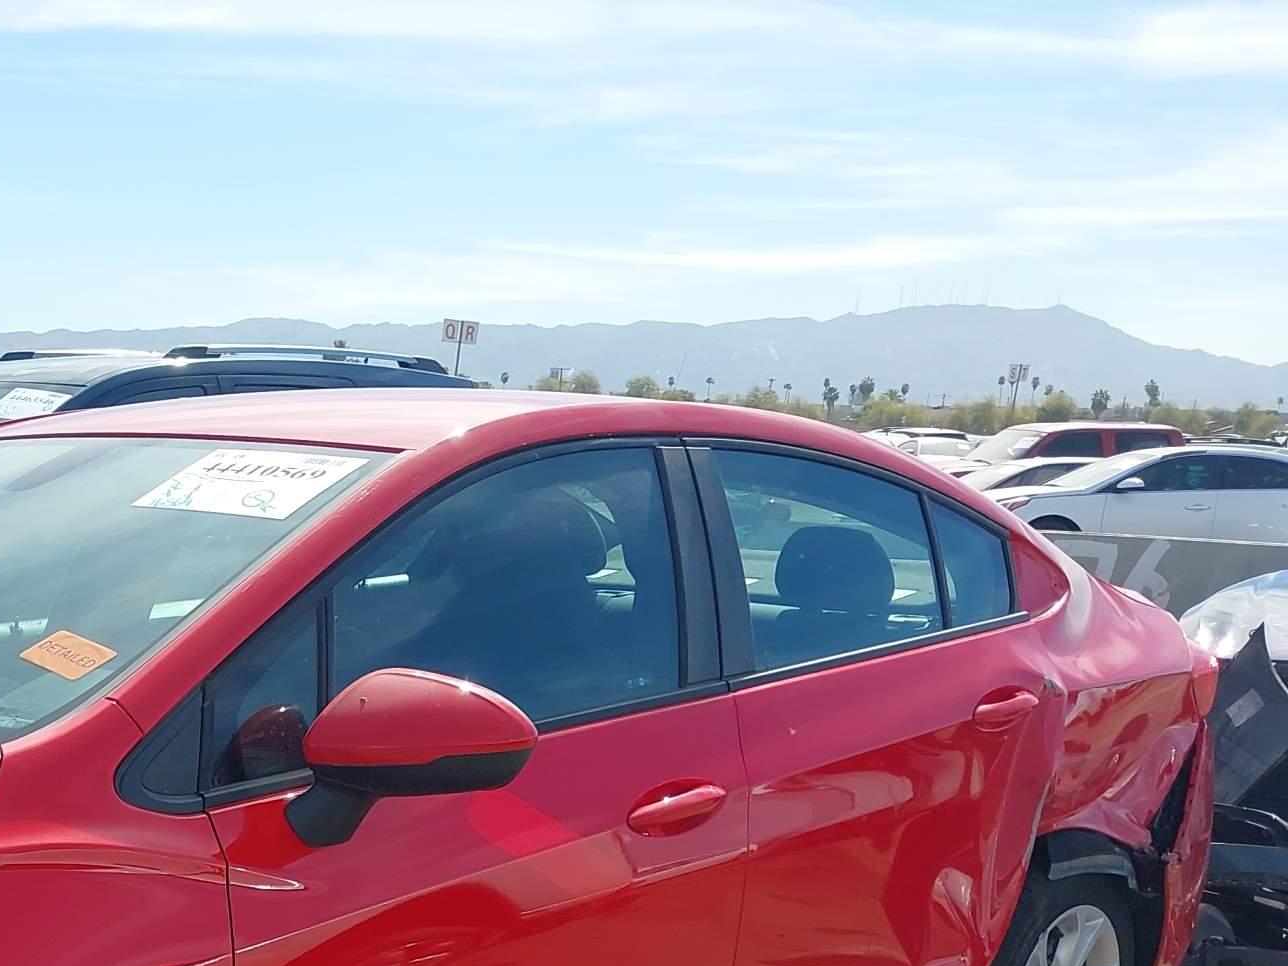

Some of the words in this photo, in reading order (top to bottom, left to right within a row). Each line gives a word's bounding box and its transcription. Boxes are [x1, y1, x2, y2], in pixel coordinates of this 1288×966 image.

[445, 323, 456, 340] Q
[465, 325, 475, 342] R
[202, 461, 327, 481] 44410569
[37, 640, 97, 669] DETAILED
